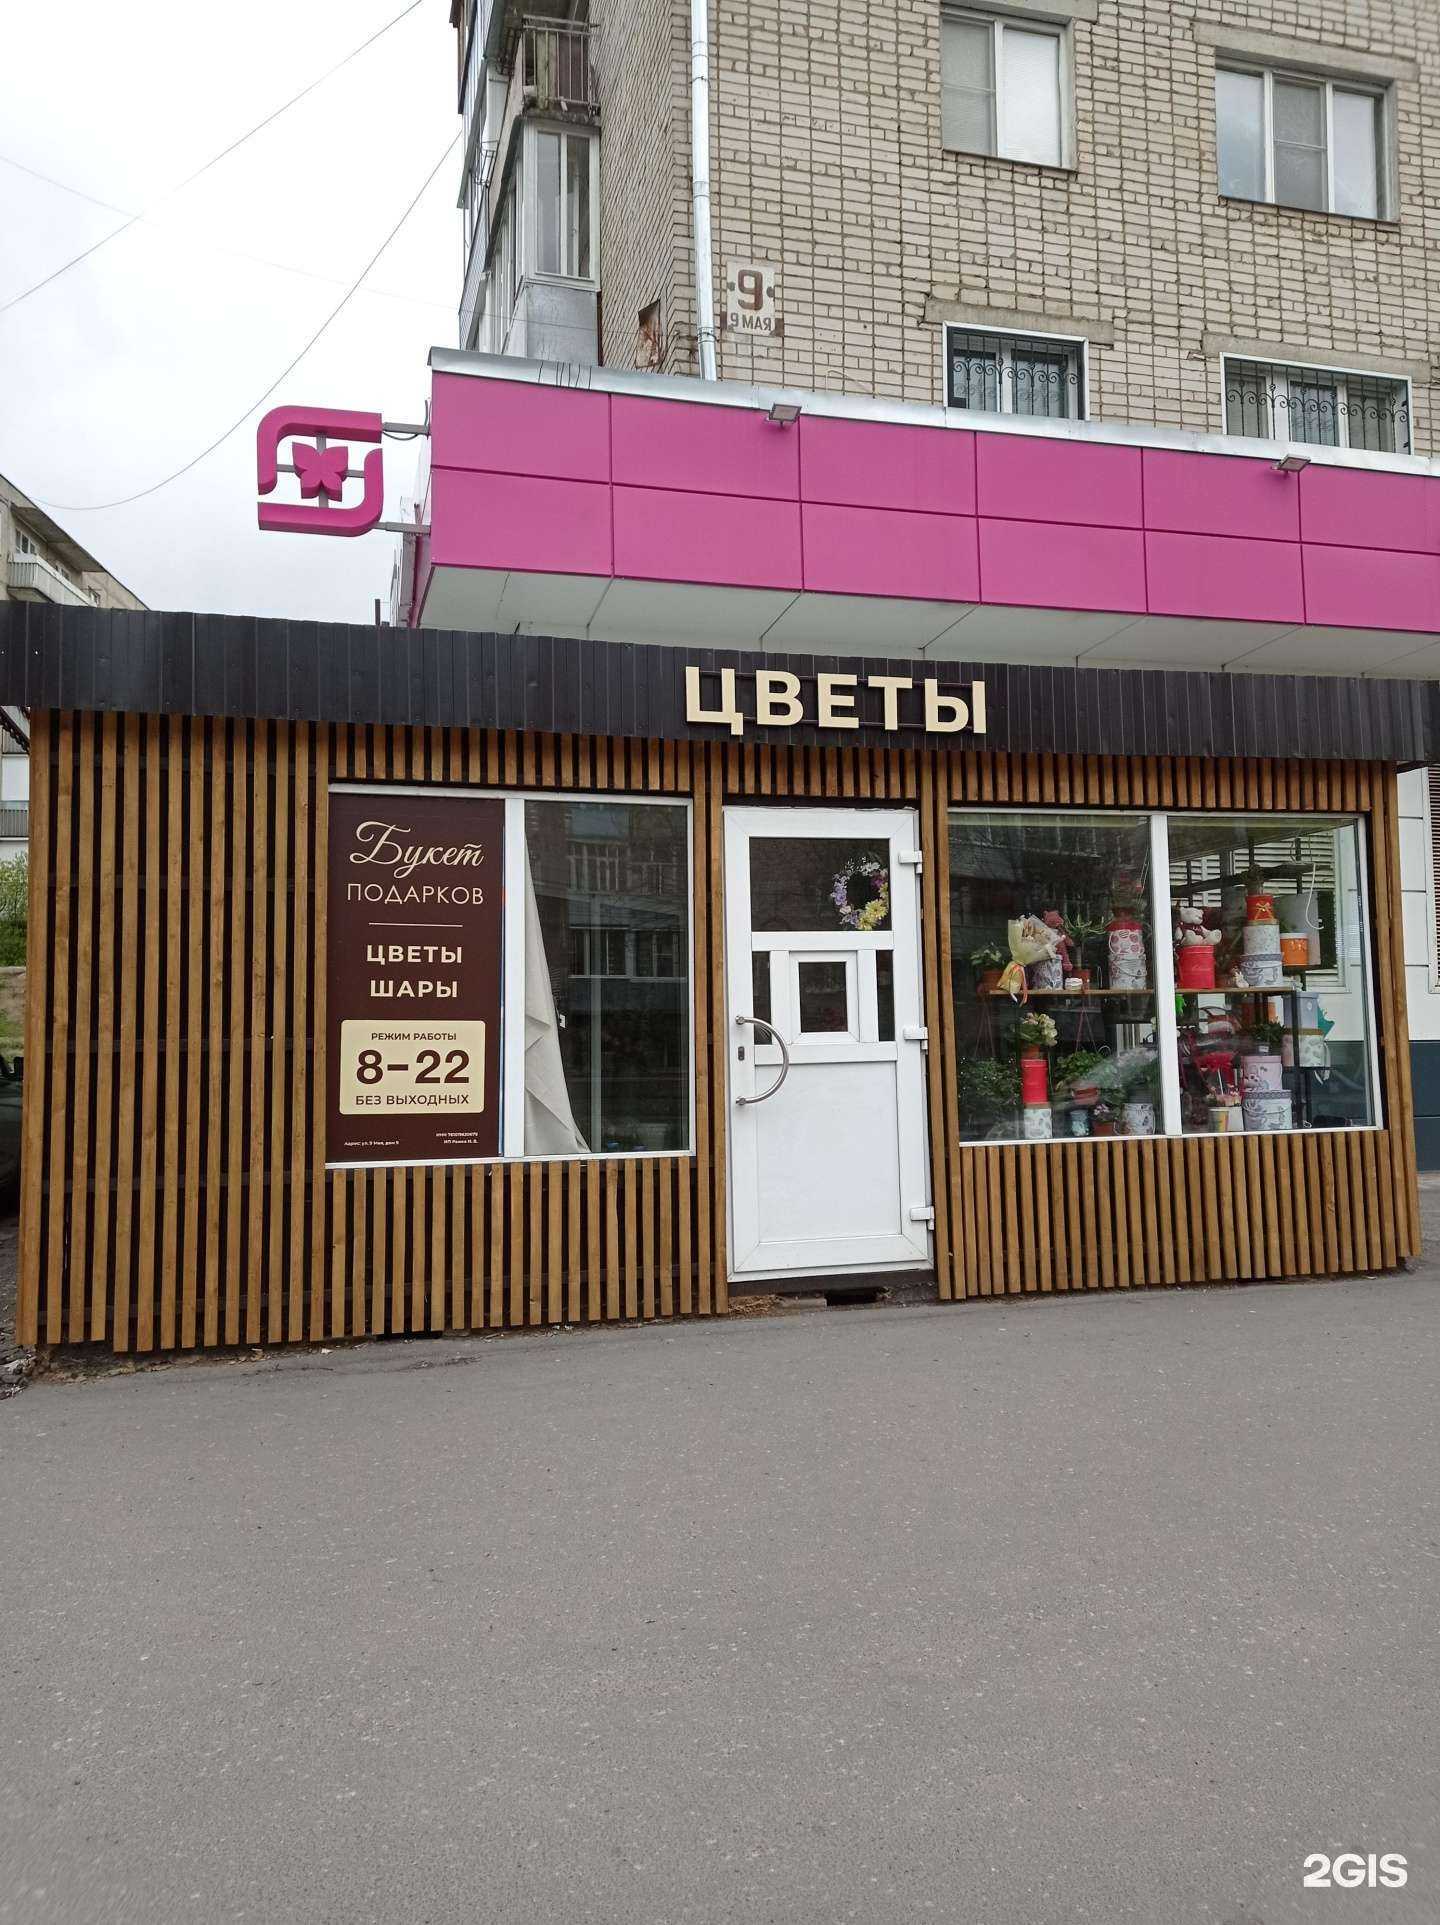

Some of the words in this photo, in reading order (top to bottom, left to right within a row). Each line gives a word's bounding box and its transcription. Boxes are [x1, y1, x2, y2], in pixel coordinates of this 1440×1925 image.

[738, 269, 764, 311] 9
[730, 312, 739, 327] 9
[742, 314, 772, 331] МАЯ
[685, 666, 987, 736] ЦВЕТЫ
[349, 820, 484, 879] Букет
[347, 883, 484, 905] ПОДАРКОВ
[366, 944, 462, 966] ЦВЕТЫ
[370, 980, 458, 998] ШАРЫ
[371, 1032, 411, 1041] РЕЖИМ
[413, 1032, 457, 1041] РАБОТЫ
[355, 1095, 382, 1106] БЕЗ
[386, 1094, 470, 1106] ВЫХОДНЫХ
